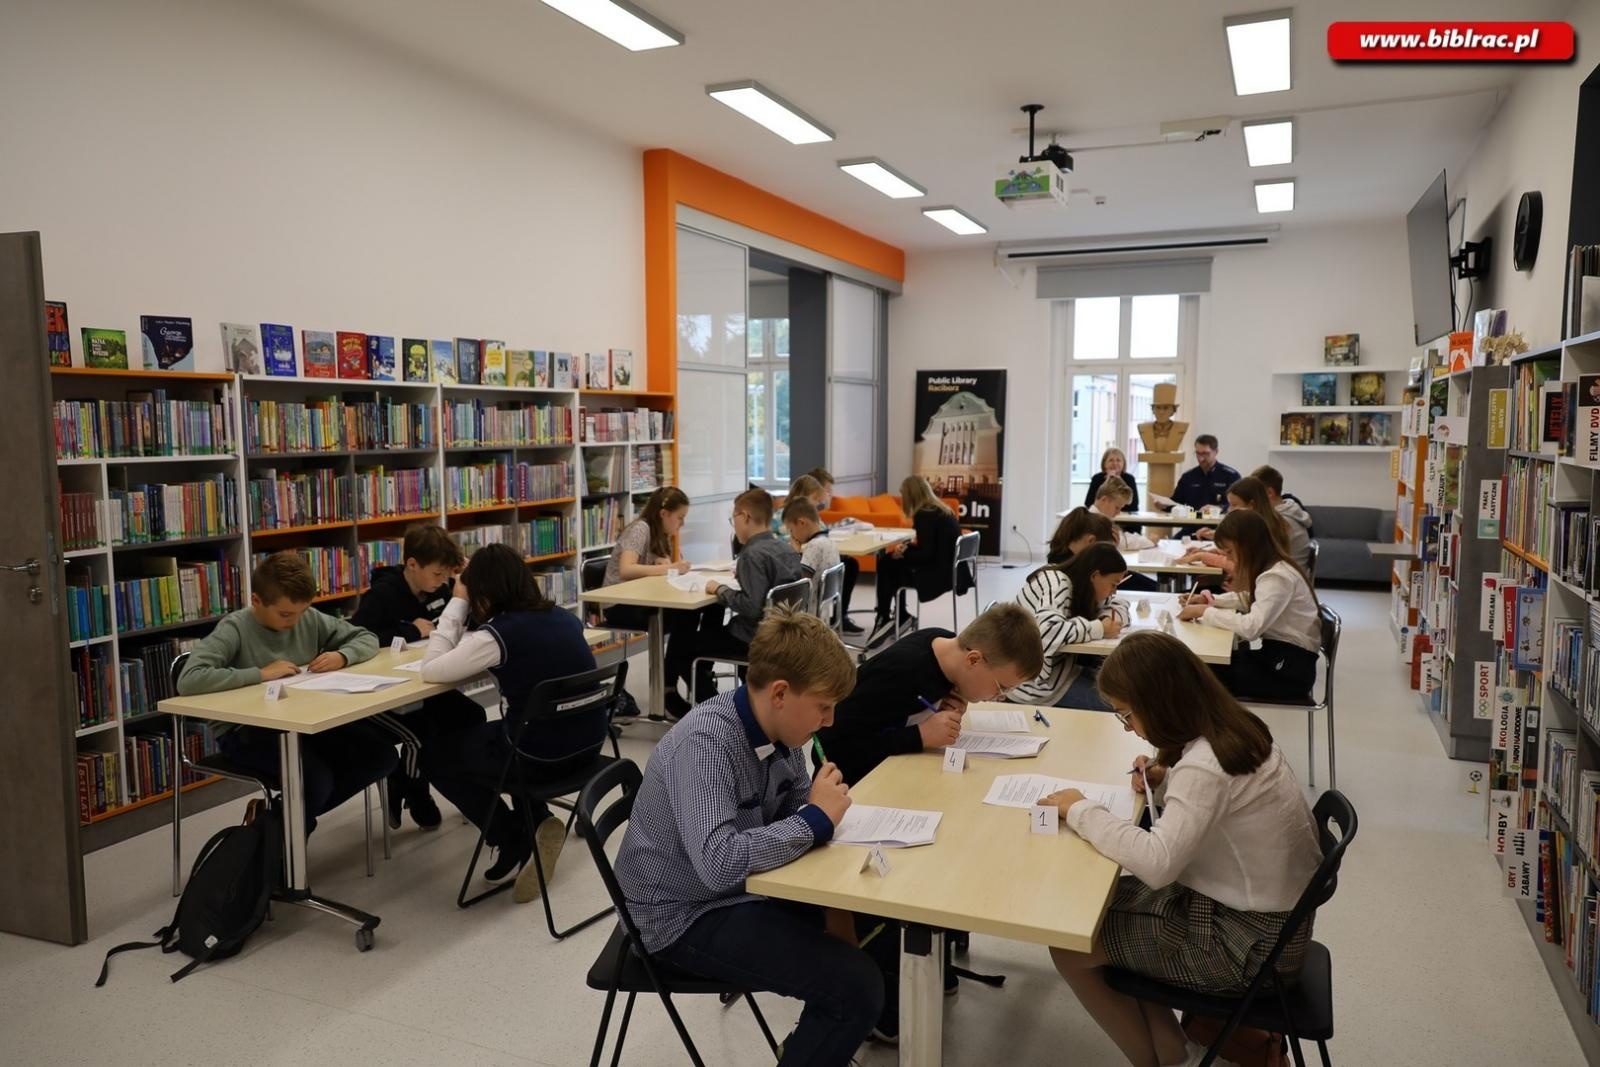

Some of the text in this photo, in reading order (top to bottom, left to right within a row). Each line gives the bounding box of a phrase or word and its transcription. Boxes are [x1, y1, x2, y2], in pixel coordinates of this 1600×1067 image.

[928, 377, 978, 386] Public Library
[1589, 408, 1600, 462] FILMY DVD
[1437, 473, 1445, 507] DINOZAURY
[1490, 482, 1498, 519] PLASTYCZNE
[971, 503, 990, 518] In
[1488, 594, 1496, 630] ORIGAMI
[1505, 600, 1513, 632] ZWYCZAJE
[1479, 664, 1489, 698] SPORT
[1498, 705, 1509, 748] EKOLOGIA
[948, 751, 956, 767] 4
[1039, 811, 1048, 827] 1
[1497, 813, 1507, 852] HOBBY
[1508, 872, 1516, 888] GRY
[1521, 861, 1530, 896] ZABAWY
